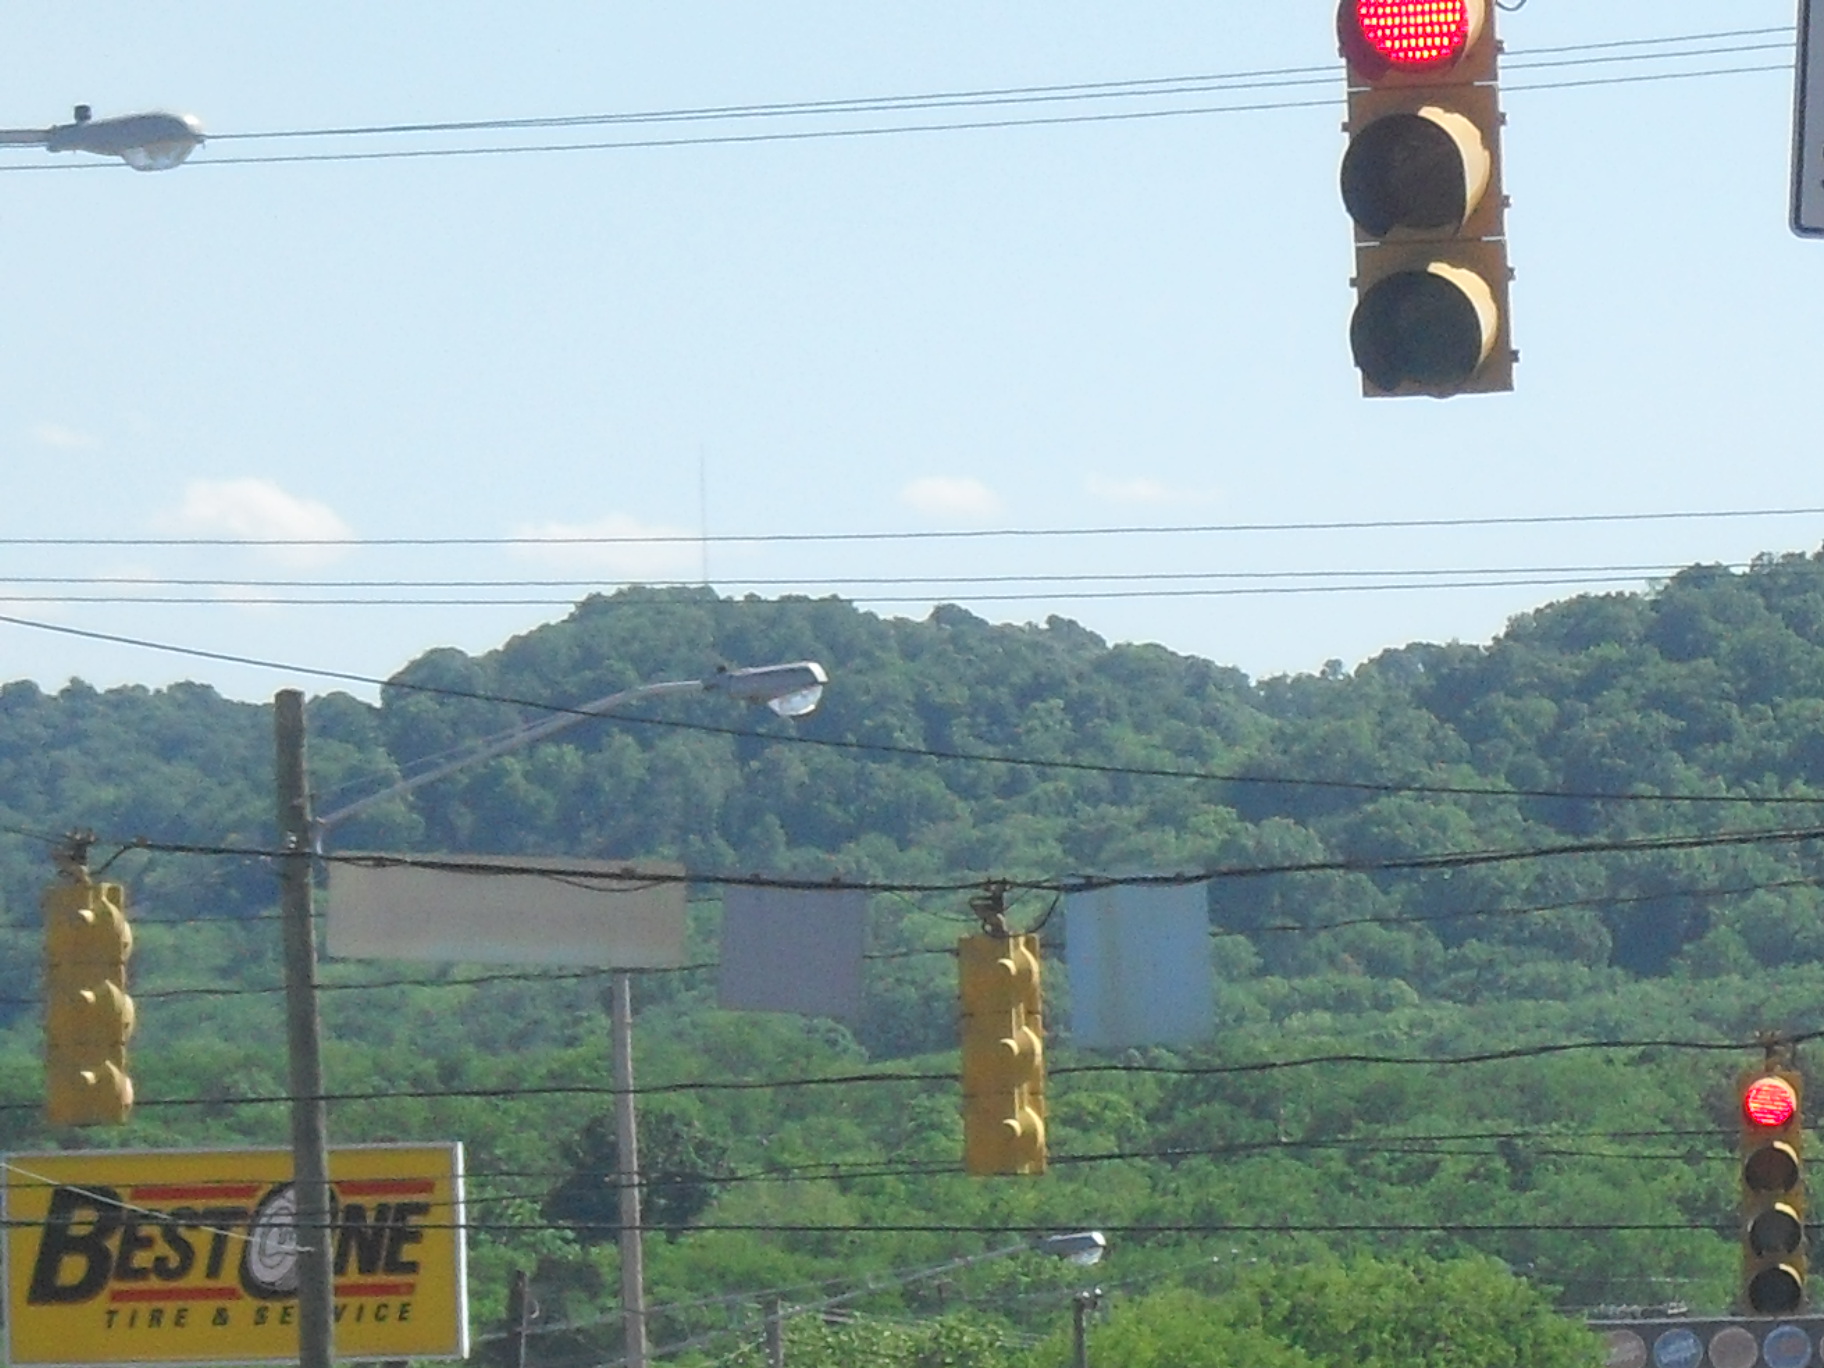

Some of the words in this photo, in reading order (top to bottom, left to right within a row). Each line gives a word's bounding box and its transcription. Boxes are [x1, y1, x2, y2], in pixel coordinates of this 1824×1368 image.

[105, 1307, 189, 1329] TIRE
[212, 1306, 230, 1327] &
[254, 1303, 411, 1326] SEVICE
